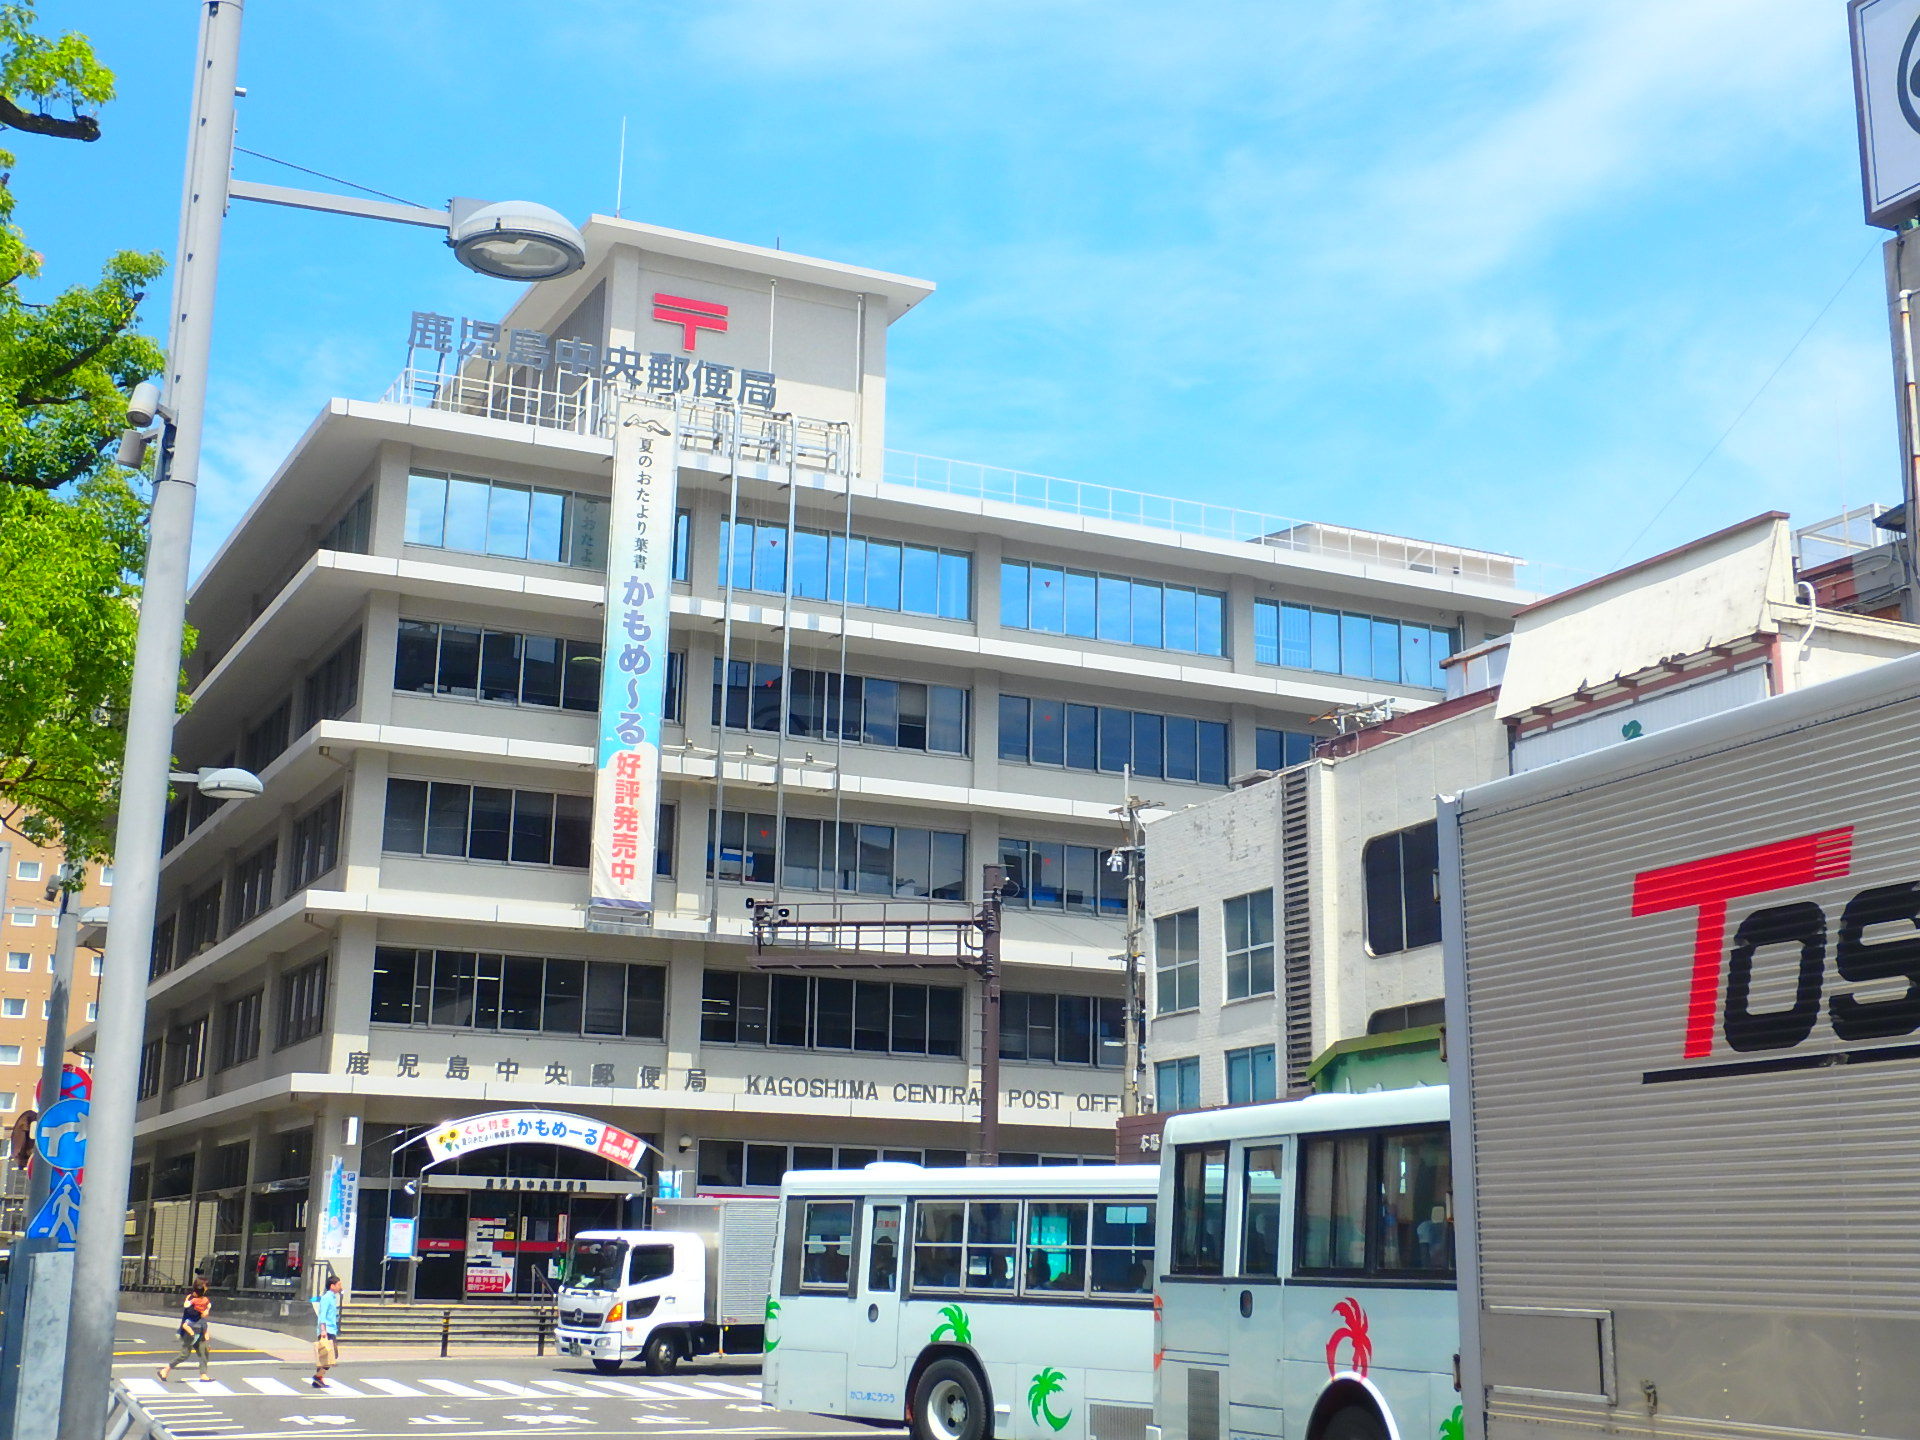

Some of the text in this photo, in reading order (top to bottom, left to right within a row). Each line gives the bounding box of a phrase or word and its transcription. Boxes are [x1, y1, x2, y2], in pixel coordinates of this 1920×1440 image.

[407, 310, 777, 410] 鹿児島中央郵便局
[633, 437, 654, 571] 夏のおたより葉書
[611, 752, 642, 886] 好評発売中
[345, 1051, 707, 1092] 鹿児島中央郵便局
[745, 1074, 879, 1101] KAGOSHIMA
[893, 1083, 982, 1106] CENTRA
[1008, 1089, 1064, 1110] POST
[518, 1119, 598, 1146] かもめーる
